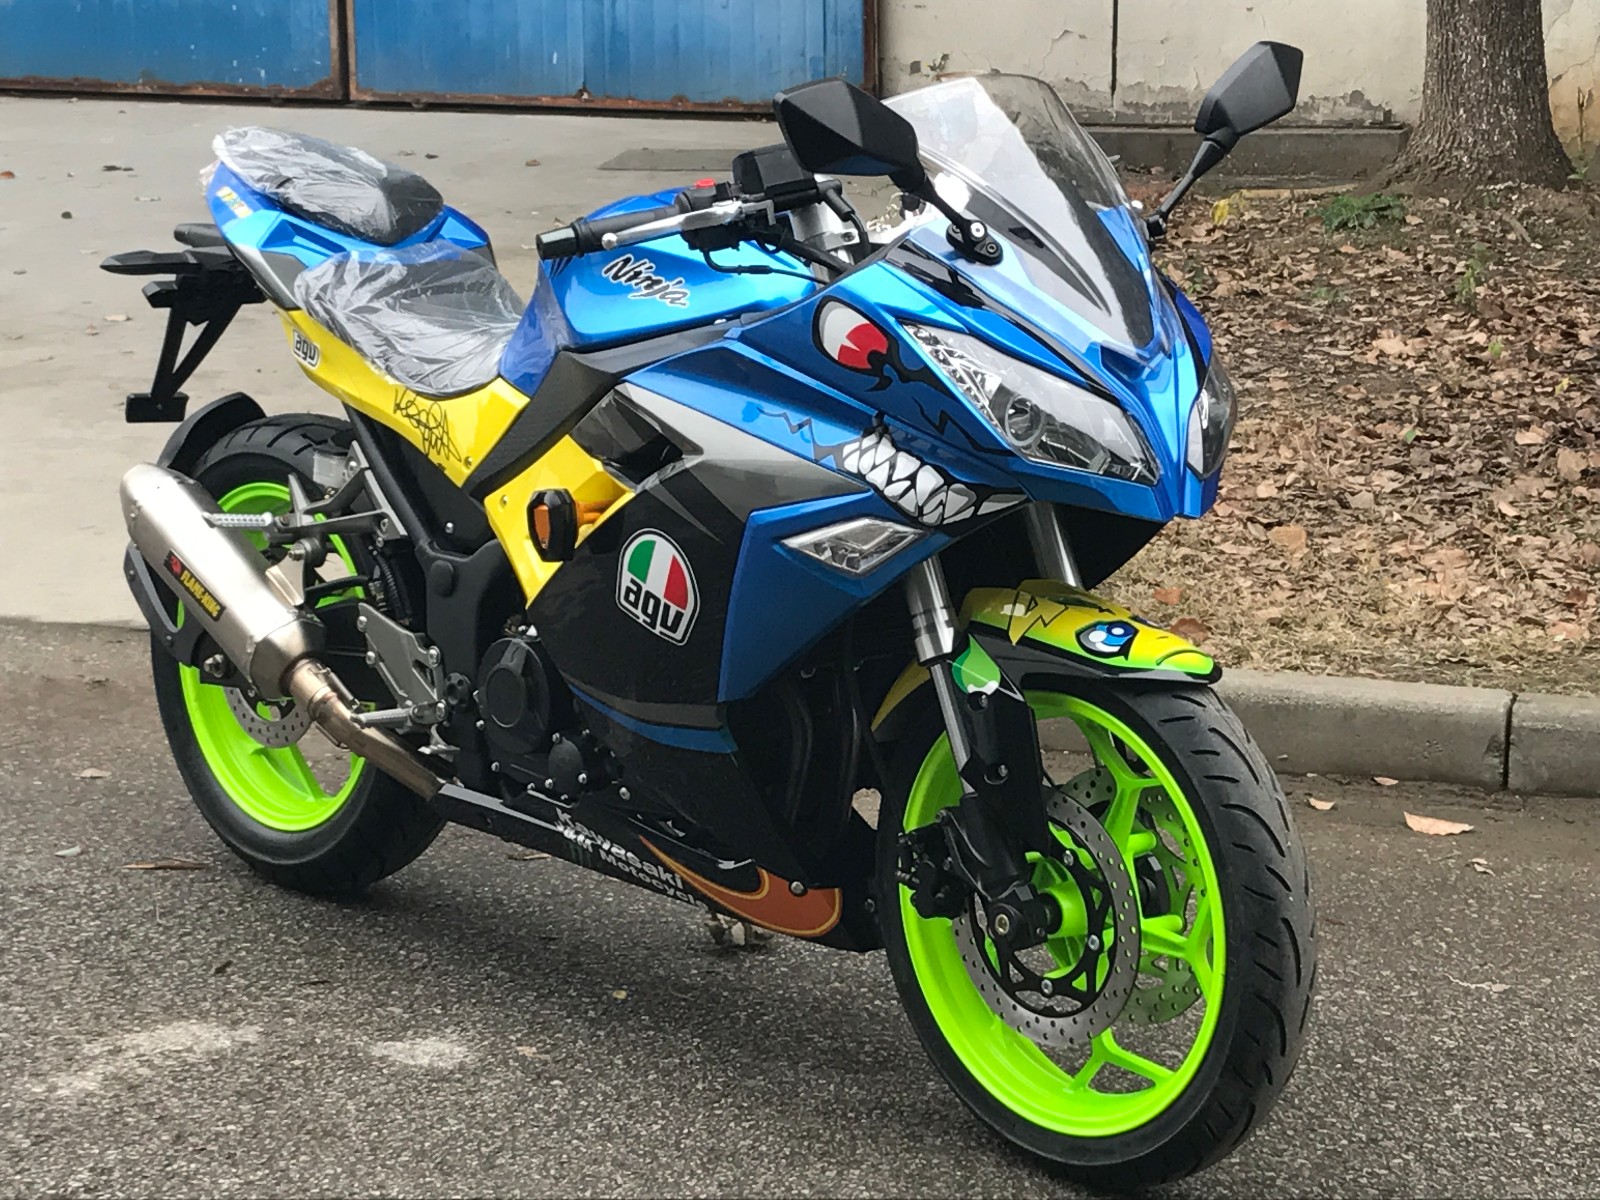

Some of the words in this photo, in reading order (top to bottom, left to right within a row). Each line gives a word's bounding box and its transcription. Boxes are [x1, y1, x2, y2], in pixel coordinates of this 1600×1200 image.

[602, 254, 690, 307] Ninja
[623, 577, 685, 635] agv
[556, 807, 684, 890] Kawasaki
